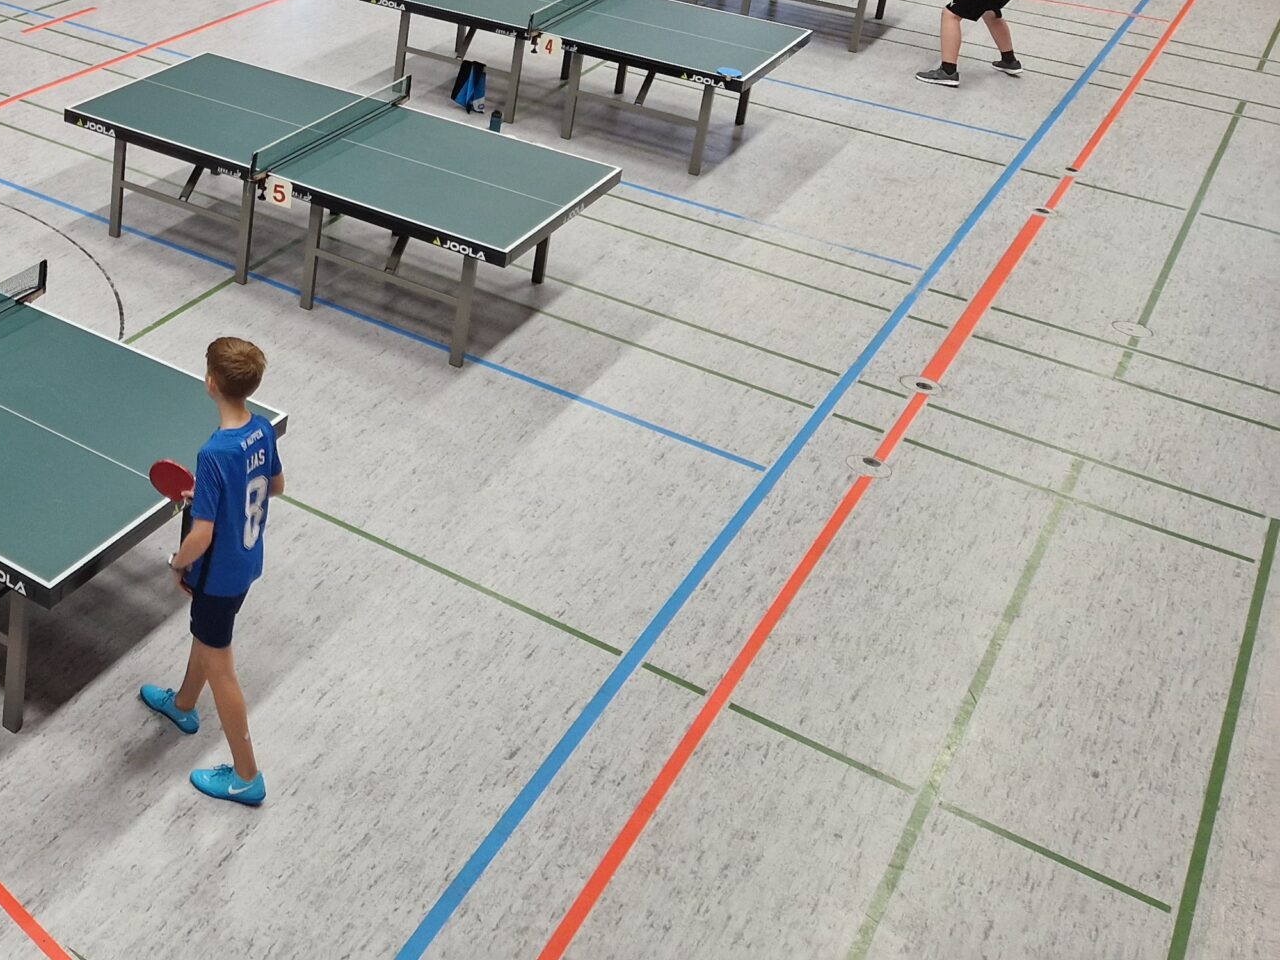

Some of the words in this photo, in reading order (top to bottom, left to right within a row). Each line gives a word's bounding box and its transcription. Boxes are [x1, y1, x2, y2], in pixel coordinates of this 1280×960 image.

[545, 39, 553, 55] 4
[689, 74, 726, 89] JOOLA
[84, 121, 116, 138] JOOLA
[272, 184, 286, 203] 5
[443, 240, 486, 261] JOOLA
